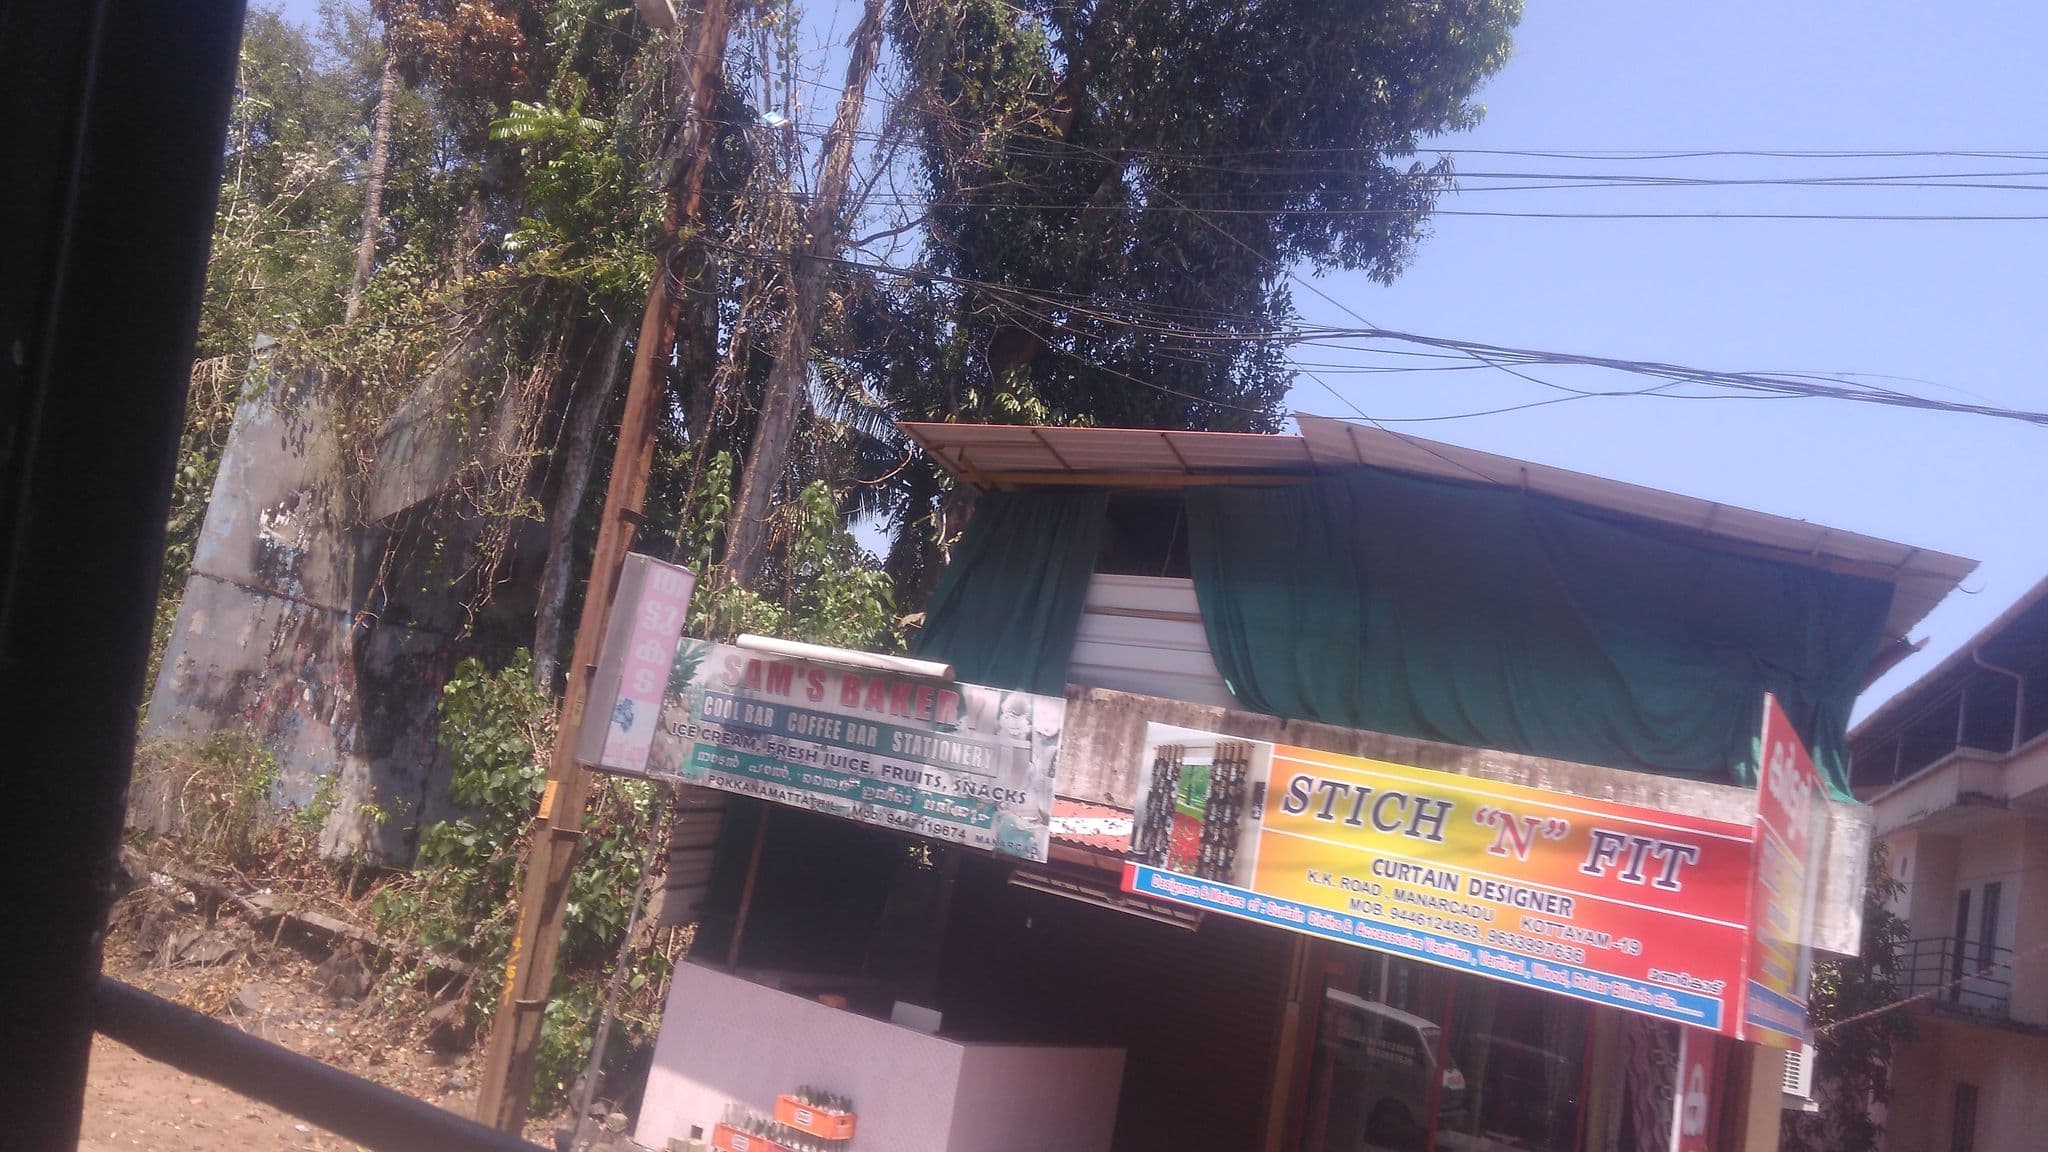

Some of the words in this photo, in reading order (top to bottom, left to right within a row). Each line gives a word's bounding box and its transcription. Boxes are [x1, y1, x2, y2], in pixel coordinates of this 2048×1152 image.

[723, 654, 827, 702] SAM'S
[703, 695, 739, 720] COOL
[745, 703, 775, 728] BAR
[787, 711, 840, 741] COFFEE
[845, 723, 878, 748] BAR
[892, 731, 992, 769] STATIONERY
[672, 722, 697, 739] ICE
[701, 728, 761, 753] CREAM,
[767, 741, 818, 764] FRESH
[822, 751, 875, 776] JUICE,
[881, 764, 947, 792] FRUITS,
[953, 779, 1027, 804] SNACKS
[1281, 775, 1454, 843] STICH
[1580, 829, 1698, 891] FIT
[1151, 874, 1199, 897] Designers
[1350, 898, 1385, 916] MOB.
[1372, 858, 1460, 892] CURTAIN
[1469, 878, 1573, 918] DESIGNER
[1393, 888, 1494, 922] MANARCADU
